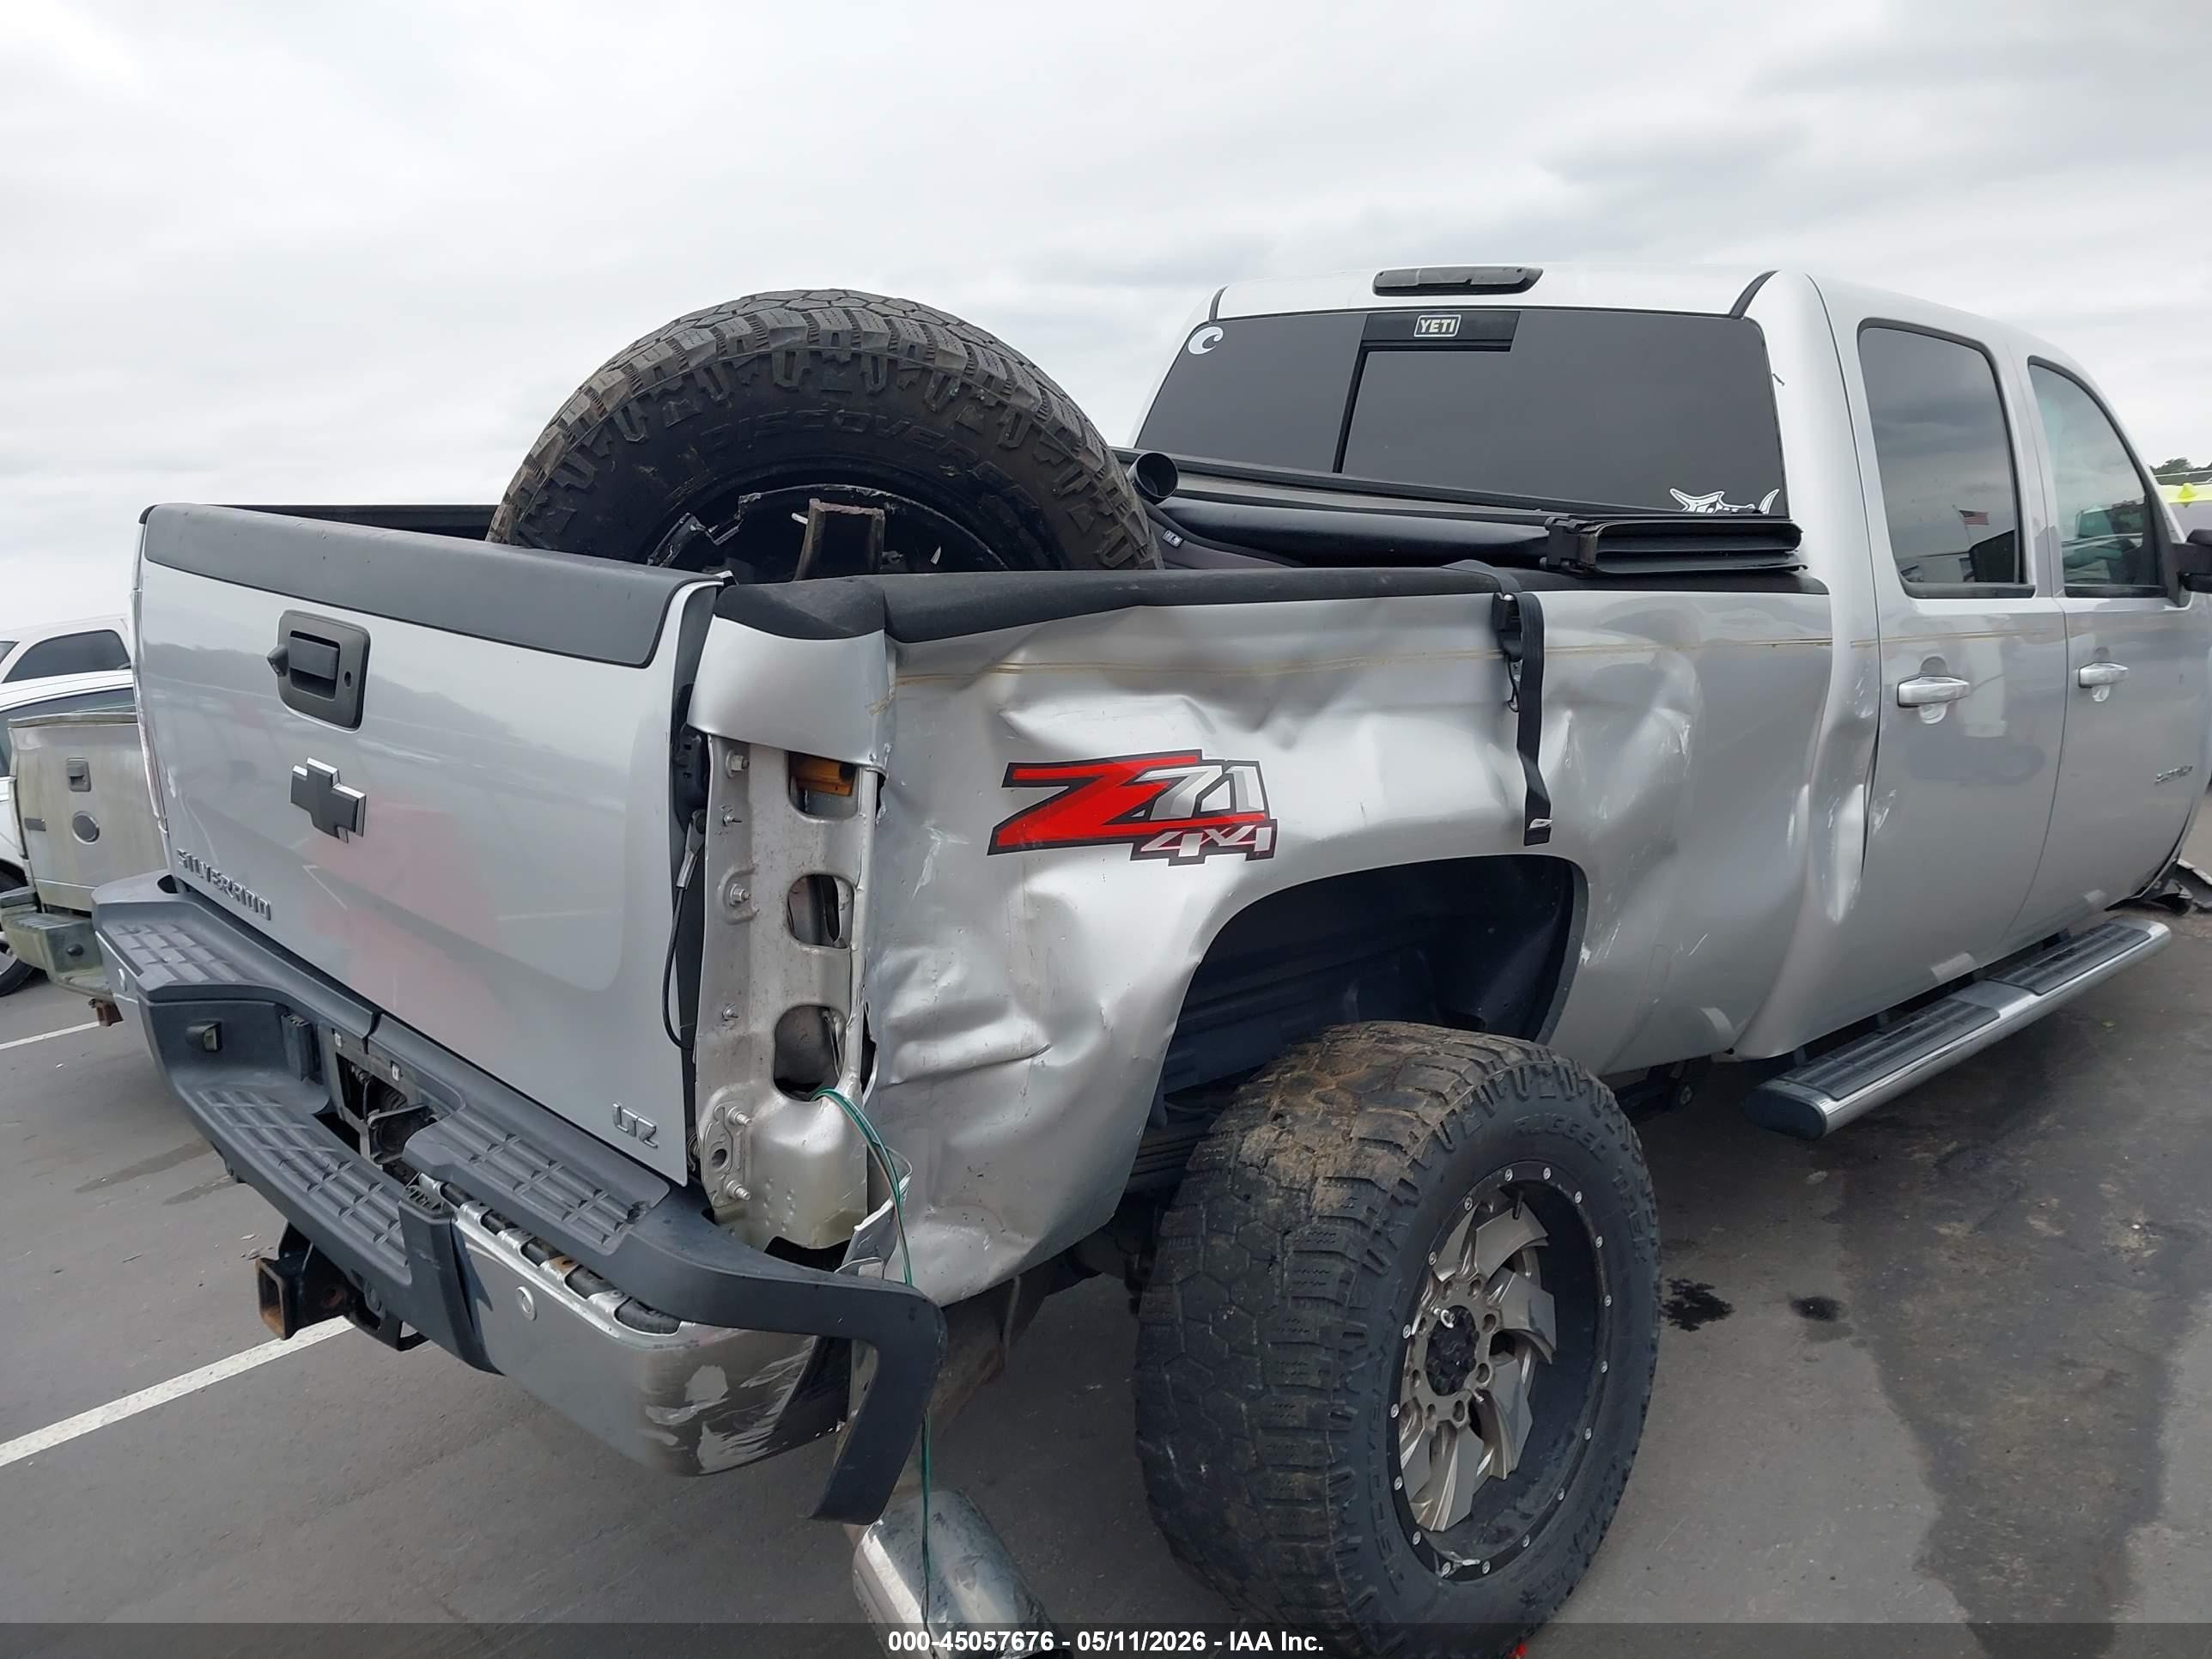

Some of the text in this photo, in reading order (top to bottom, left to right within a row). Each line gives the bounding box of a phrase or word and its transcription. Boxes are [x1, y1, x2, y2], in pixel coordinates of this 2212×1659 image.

[1419, 319, 1457, 333] YETI
[994, 754, 1267, 848] Z71
[177, 848, 271, 921] SILVERADO
[612, 1103, 659, 1149] LTZ
